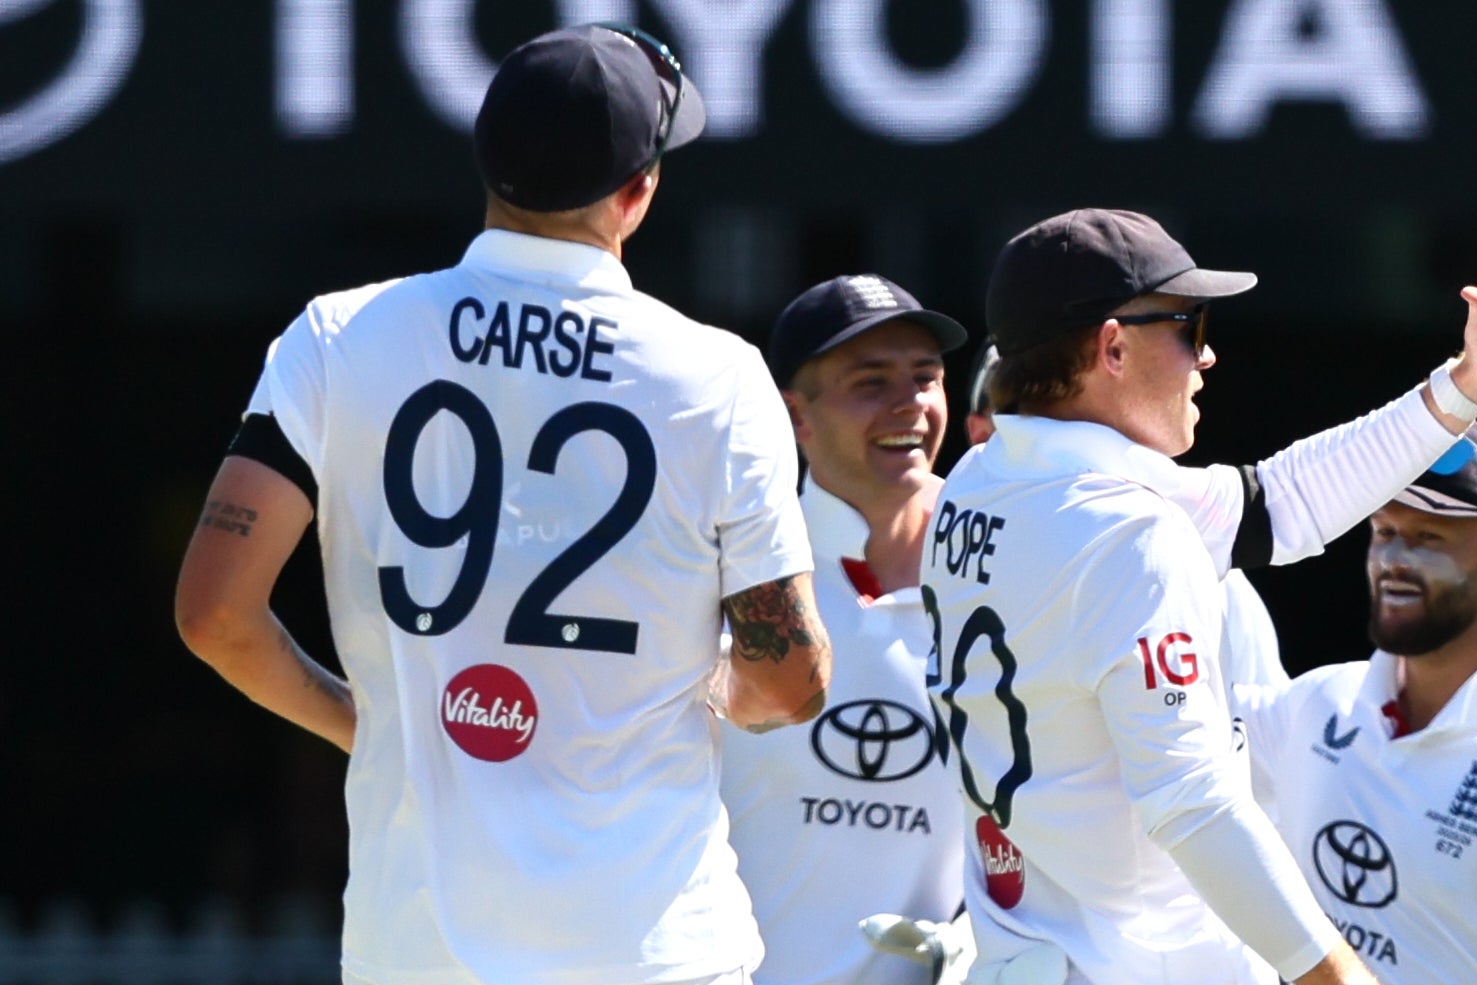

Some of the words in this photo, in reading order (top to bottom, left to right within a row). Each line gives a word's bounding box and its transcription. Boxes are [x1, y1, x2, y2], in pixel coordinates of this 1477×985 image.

[449, 296, 619, 383] CARSE
[377, 378, 658, 656] 92
[931, 500, 1006, 584] POPE
[1137, 631, 1199, 690] IG
[446, 687, 534, 743] Vitality
[801, 797, 932, 835] TOYOTA
[1325, 913, 1397, 966] YOTA
